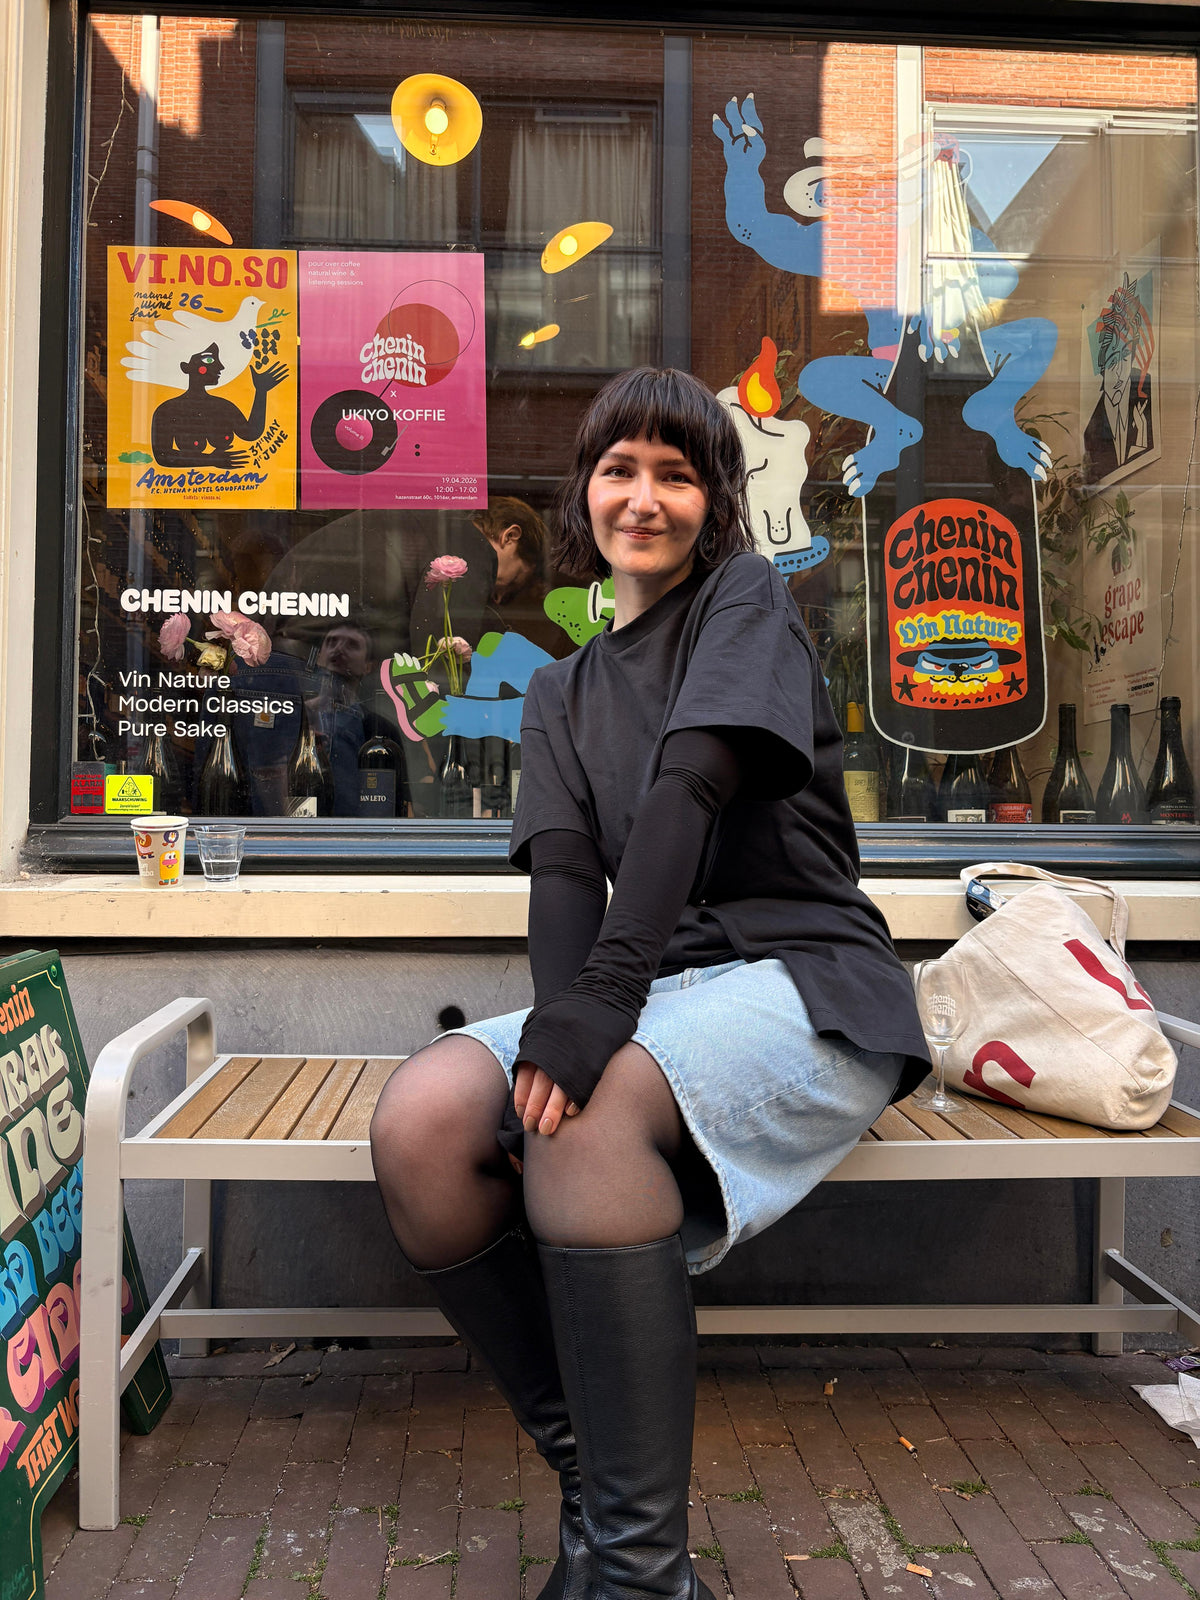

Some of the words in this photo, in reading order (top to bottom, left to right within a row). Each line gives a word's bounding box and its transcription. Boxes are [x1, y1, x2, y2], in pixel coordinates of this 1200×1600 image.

[117, 252, 289, 290] VI.NO.SO
[308, 278, 336, 286] listening
[134, 291, 173, 300] natural
[141, 300, 172, 310] wine
[130, 307, 161, 322] fair
[359, 333, 427, 364] chenin
[361, 355, 427, 387] chenin
[342, 408, 389, 421] UKIYO
[393, 408, 446, 421] KOFFIE
[262, 430, 288, 460] JUNE
[263, 419, 280, 443] MAY
[136, 467, 269, 489] Amsterdam
[888, 509, 1017, 570] chenin
[893, 553, 1020, 611] chenin
[120, 588, 232, 615] CHENIN
[238, 591, 350, 618] CHENIN
[1104, 577, 1141, 619] grape
[899, 613, 940, 644] Vin
[943, 612, 1019, 639] Nature
[1101, 611, 1145, 645] escape
[119, 670, 151, 688] Vin
[158, 671, 231, 689] Nature
[119, 696, 199, 713] Modern
[206, 696, 294, 714] Classics
[118, 720, 167, 737] Pure
[174, 720, 227, 738] Sake
[0, 984, 35, 1035] enin
[0, 1077, 84, 1238] INE
[31, 1160, 82, 1284] BEE
[7, 1257, 83, 1414] CID
[17, 1407, 62, 1489] THAT
